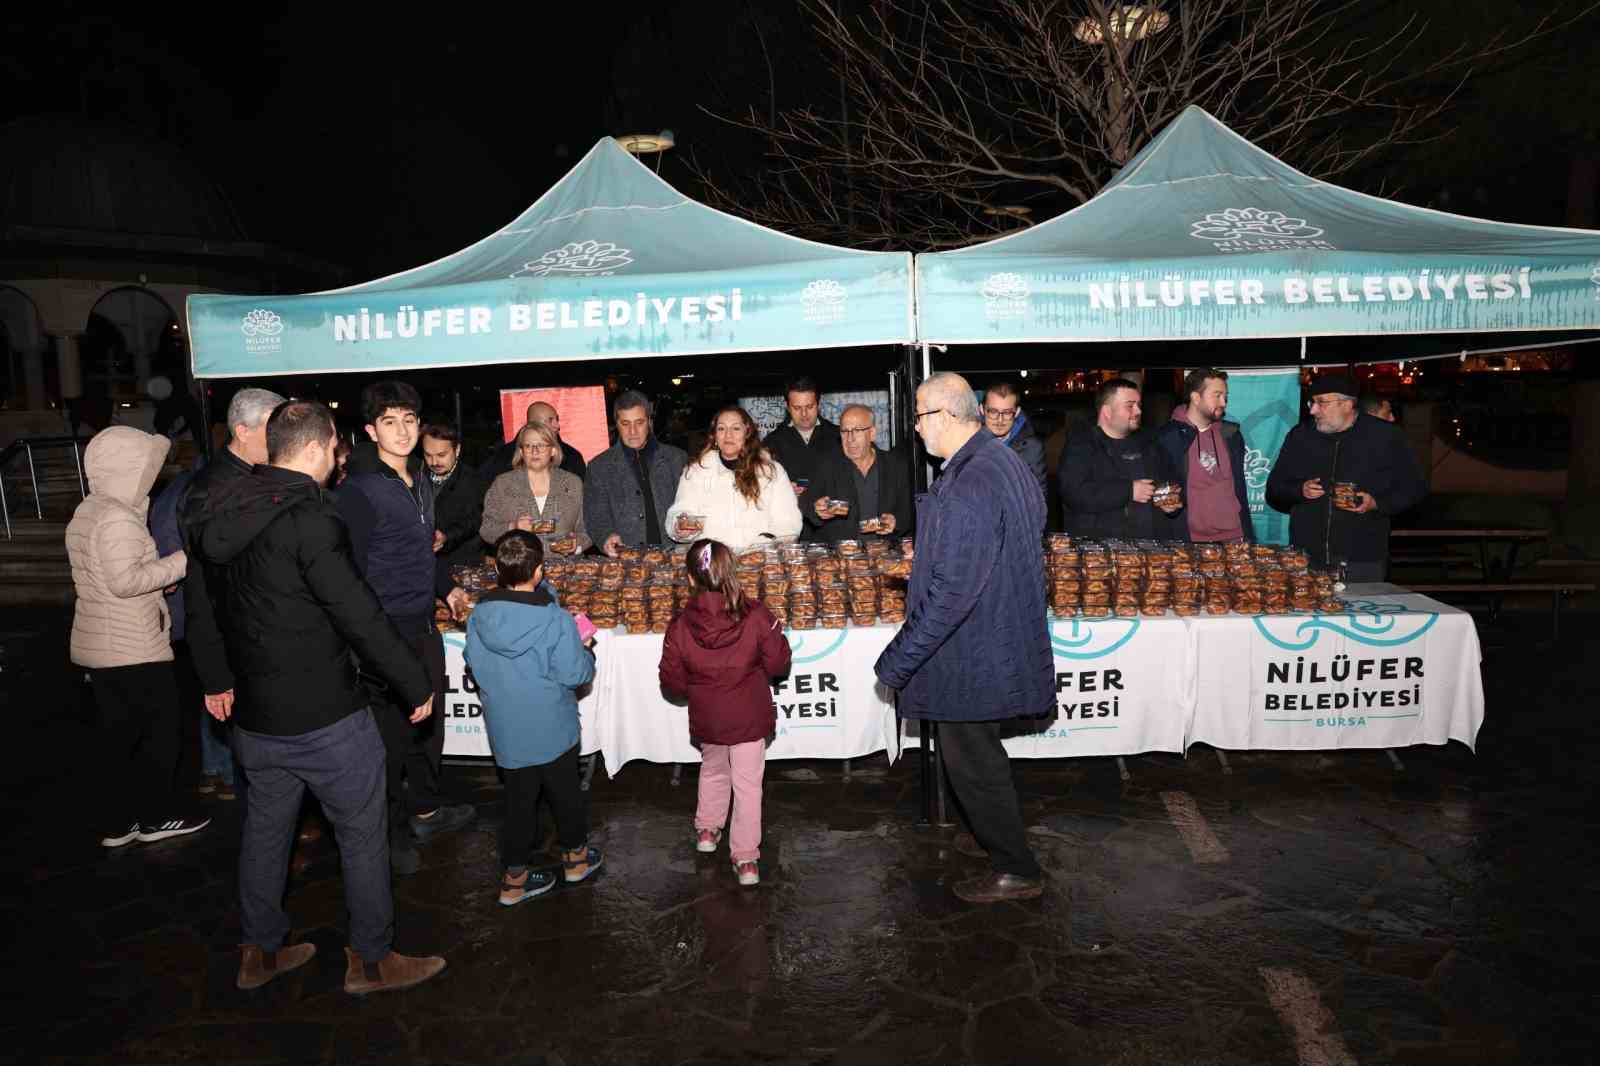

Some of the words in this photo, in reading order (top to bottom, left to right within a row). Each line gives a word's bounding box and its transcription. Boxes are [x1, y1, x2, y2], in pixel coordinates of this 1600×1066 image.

[1089, 274, 1265, 309] NİLÜFER
[1283, 266, 1532, 303] BELEDİYESİ
[334, 304, 492, 341] NİLÜFER
[509, 288, 742, 331] BELEDİYESİ
[1267, 654, 1424, 683] NİLÜFER
[1265, 684, 1420, 710] BELEDİYESİ
[455, 724, 481, 734] BUR
[1315, 717, 1366, 728] BURSA
